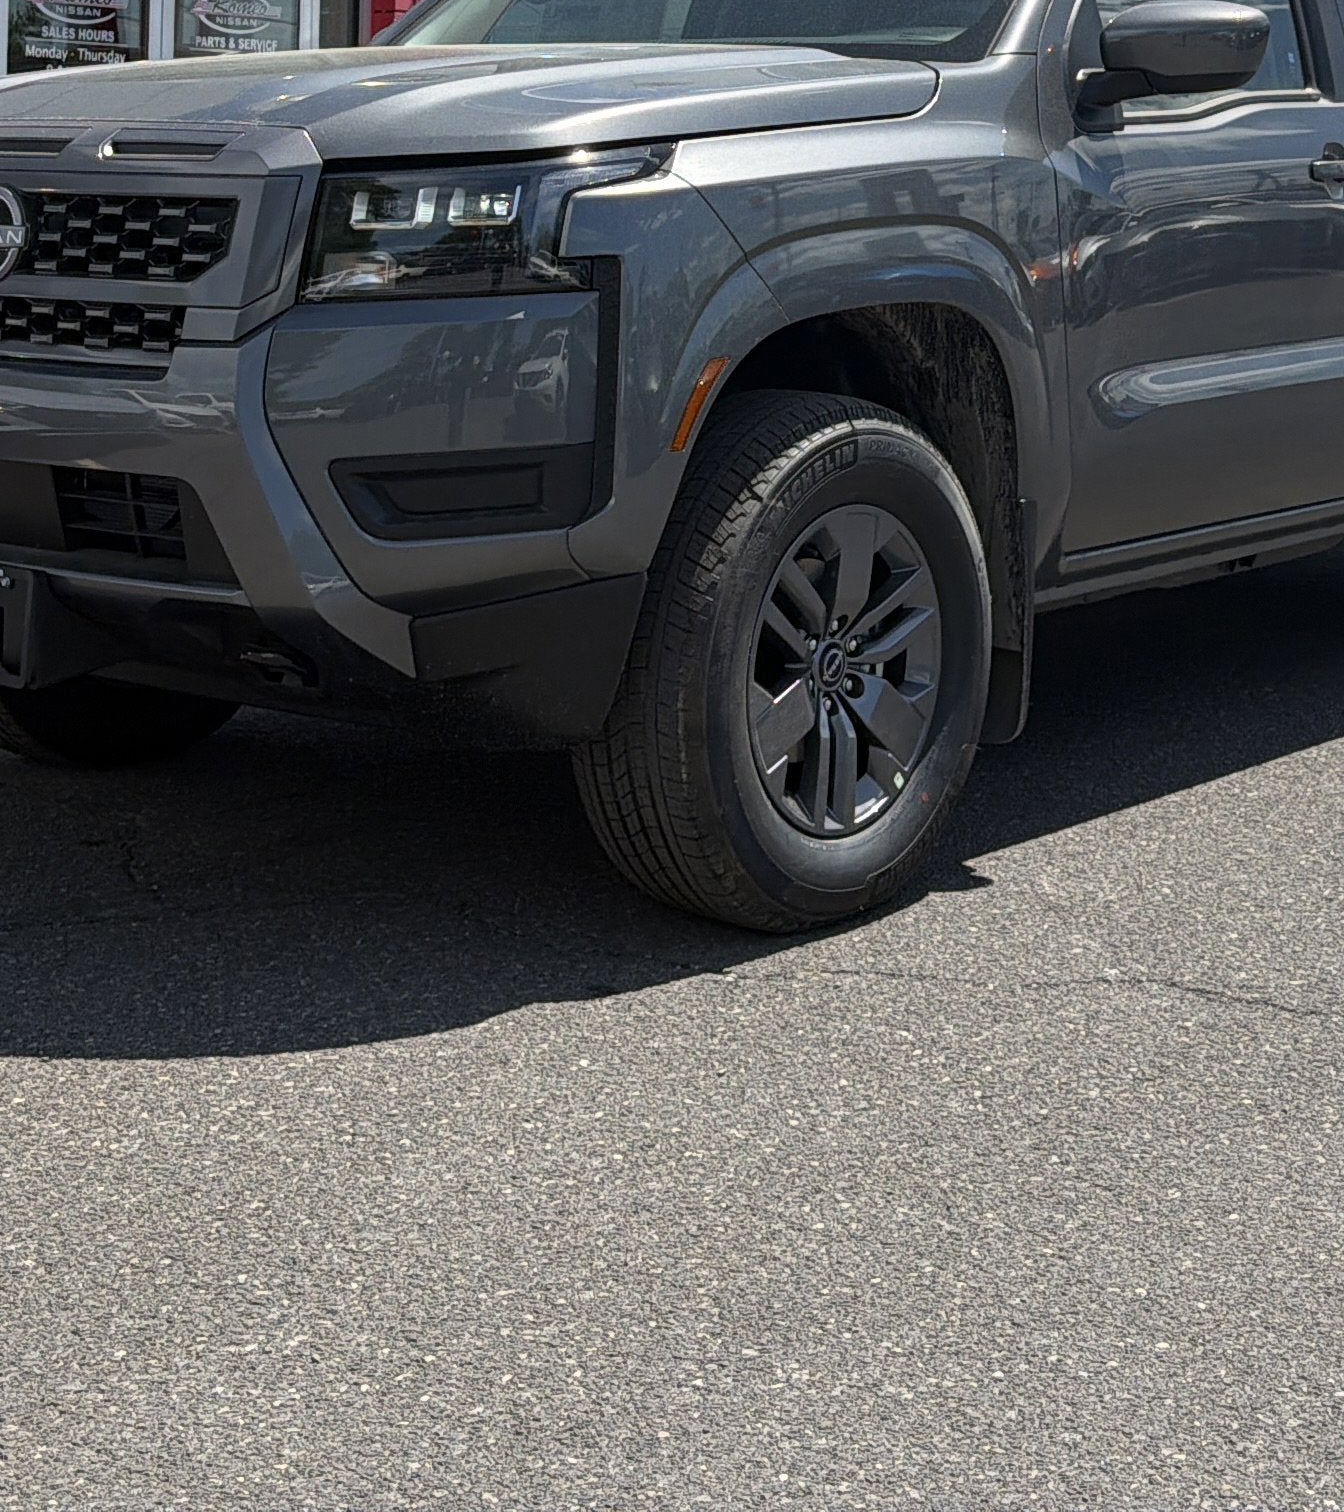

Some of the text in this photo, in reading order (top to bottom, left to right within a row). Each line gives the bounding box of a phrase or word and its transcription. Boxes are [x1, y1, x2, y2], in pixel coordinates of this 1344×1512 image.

[56, 5, 102, 17] NISSAN
[216, 15, 258, 26] NISSAN
[41, 26, 115, 42] SALES HOURS
[196, 36, 226, 48] PARTS
[228, 38, 236, 48] &
[25, 44, 126, 64] Monday Thursday
